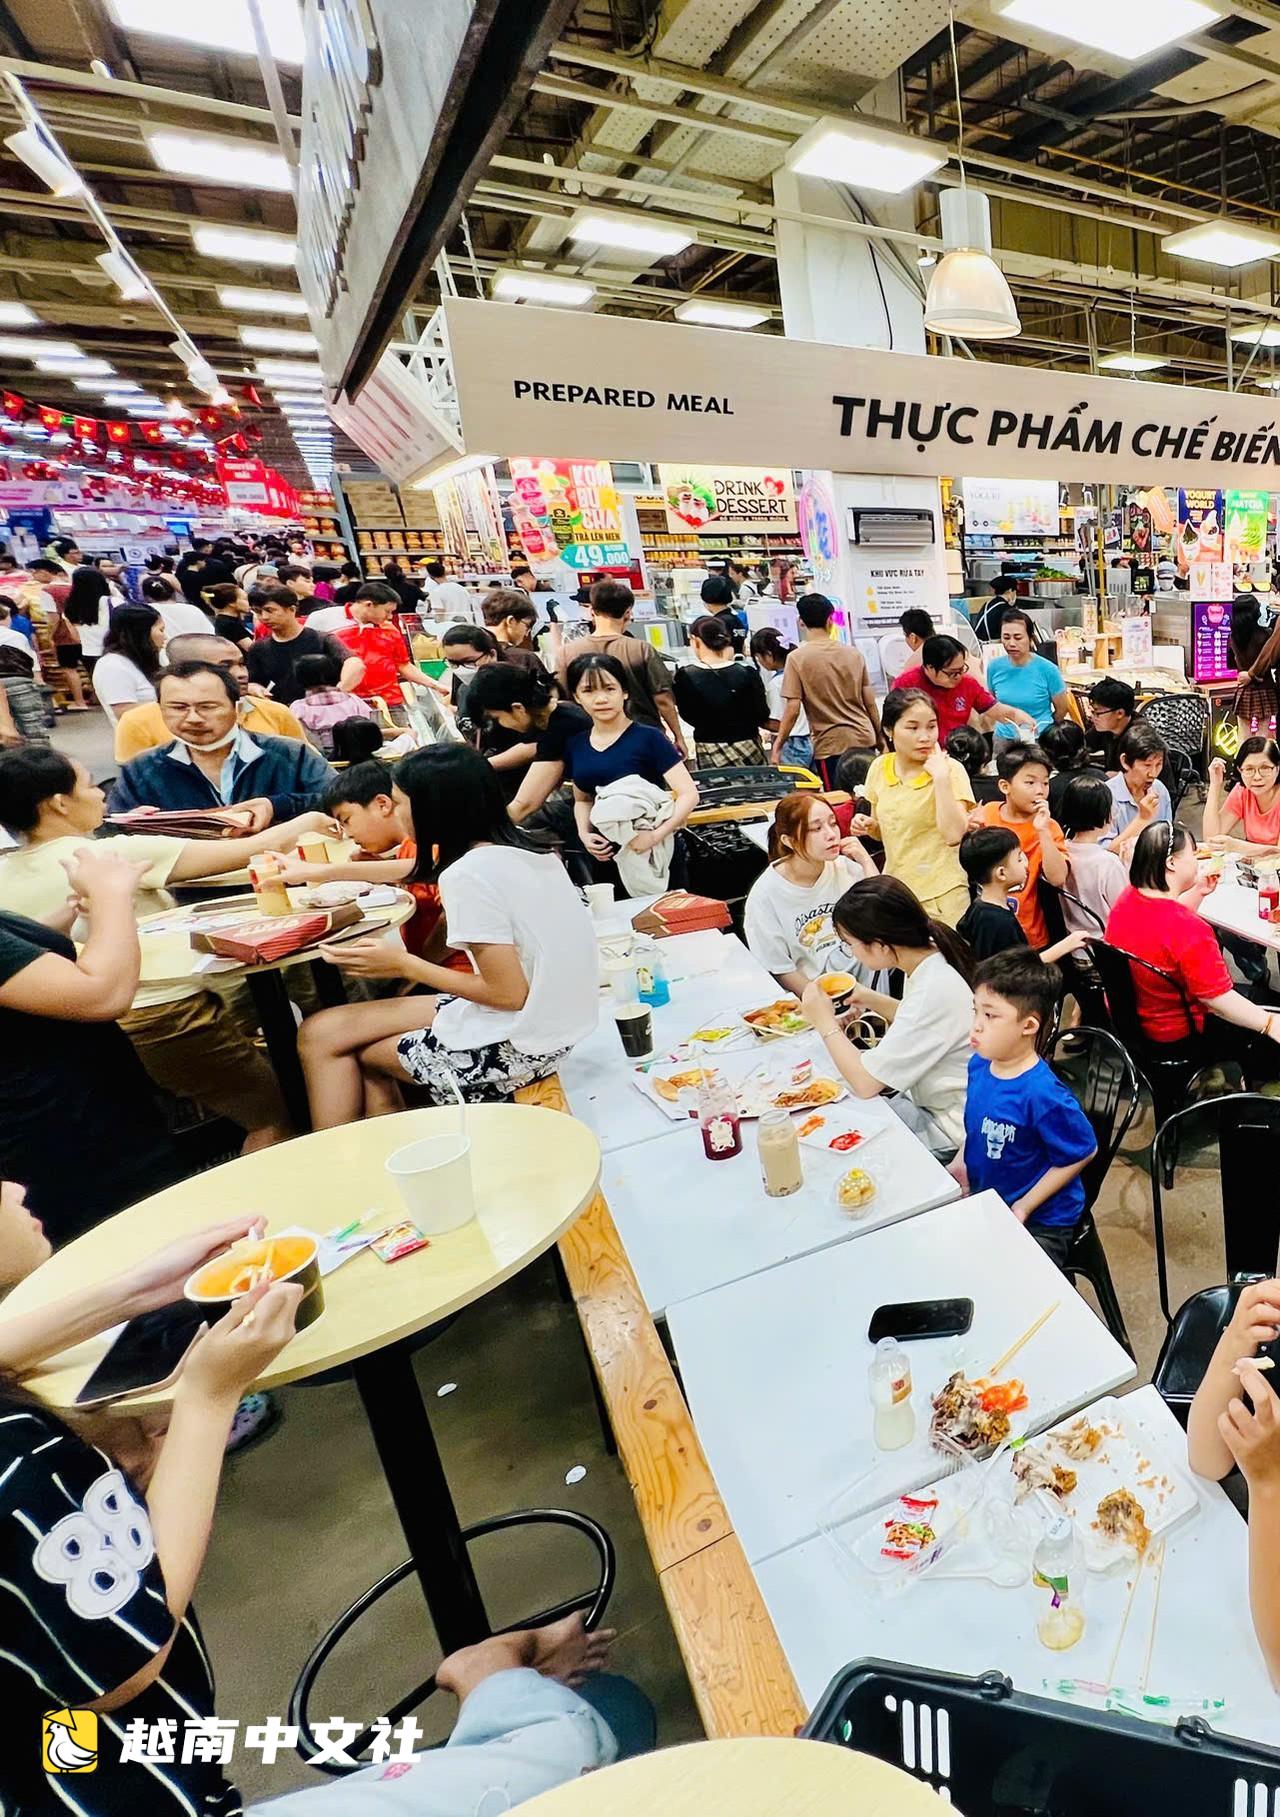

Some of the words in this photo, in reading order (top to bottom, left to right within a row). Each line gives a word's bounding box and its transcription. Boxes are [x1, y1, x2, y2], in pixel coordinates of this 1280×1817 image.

[513, 380, 656, 408] PREPARED
[666, 393, 735, 415] MEAL
[832, 395, 979, 453] THỰC
[987, 401, 1123, 454] PHẨM
[1131, 415, 1218, 460] CHẾ
[571, 463, 612, 488] KOM
[576, 487, 601, 510] BU
[714, 480, 765, 496] DRINK
[1184, 489, 1217, 500] YOGURT
[717, 499, 787, 514] DESSERT
[1186, 499, 1215, 509] WORLD
[581, 509, 618, 531] CHA
